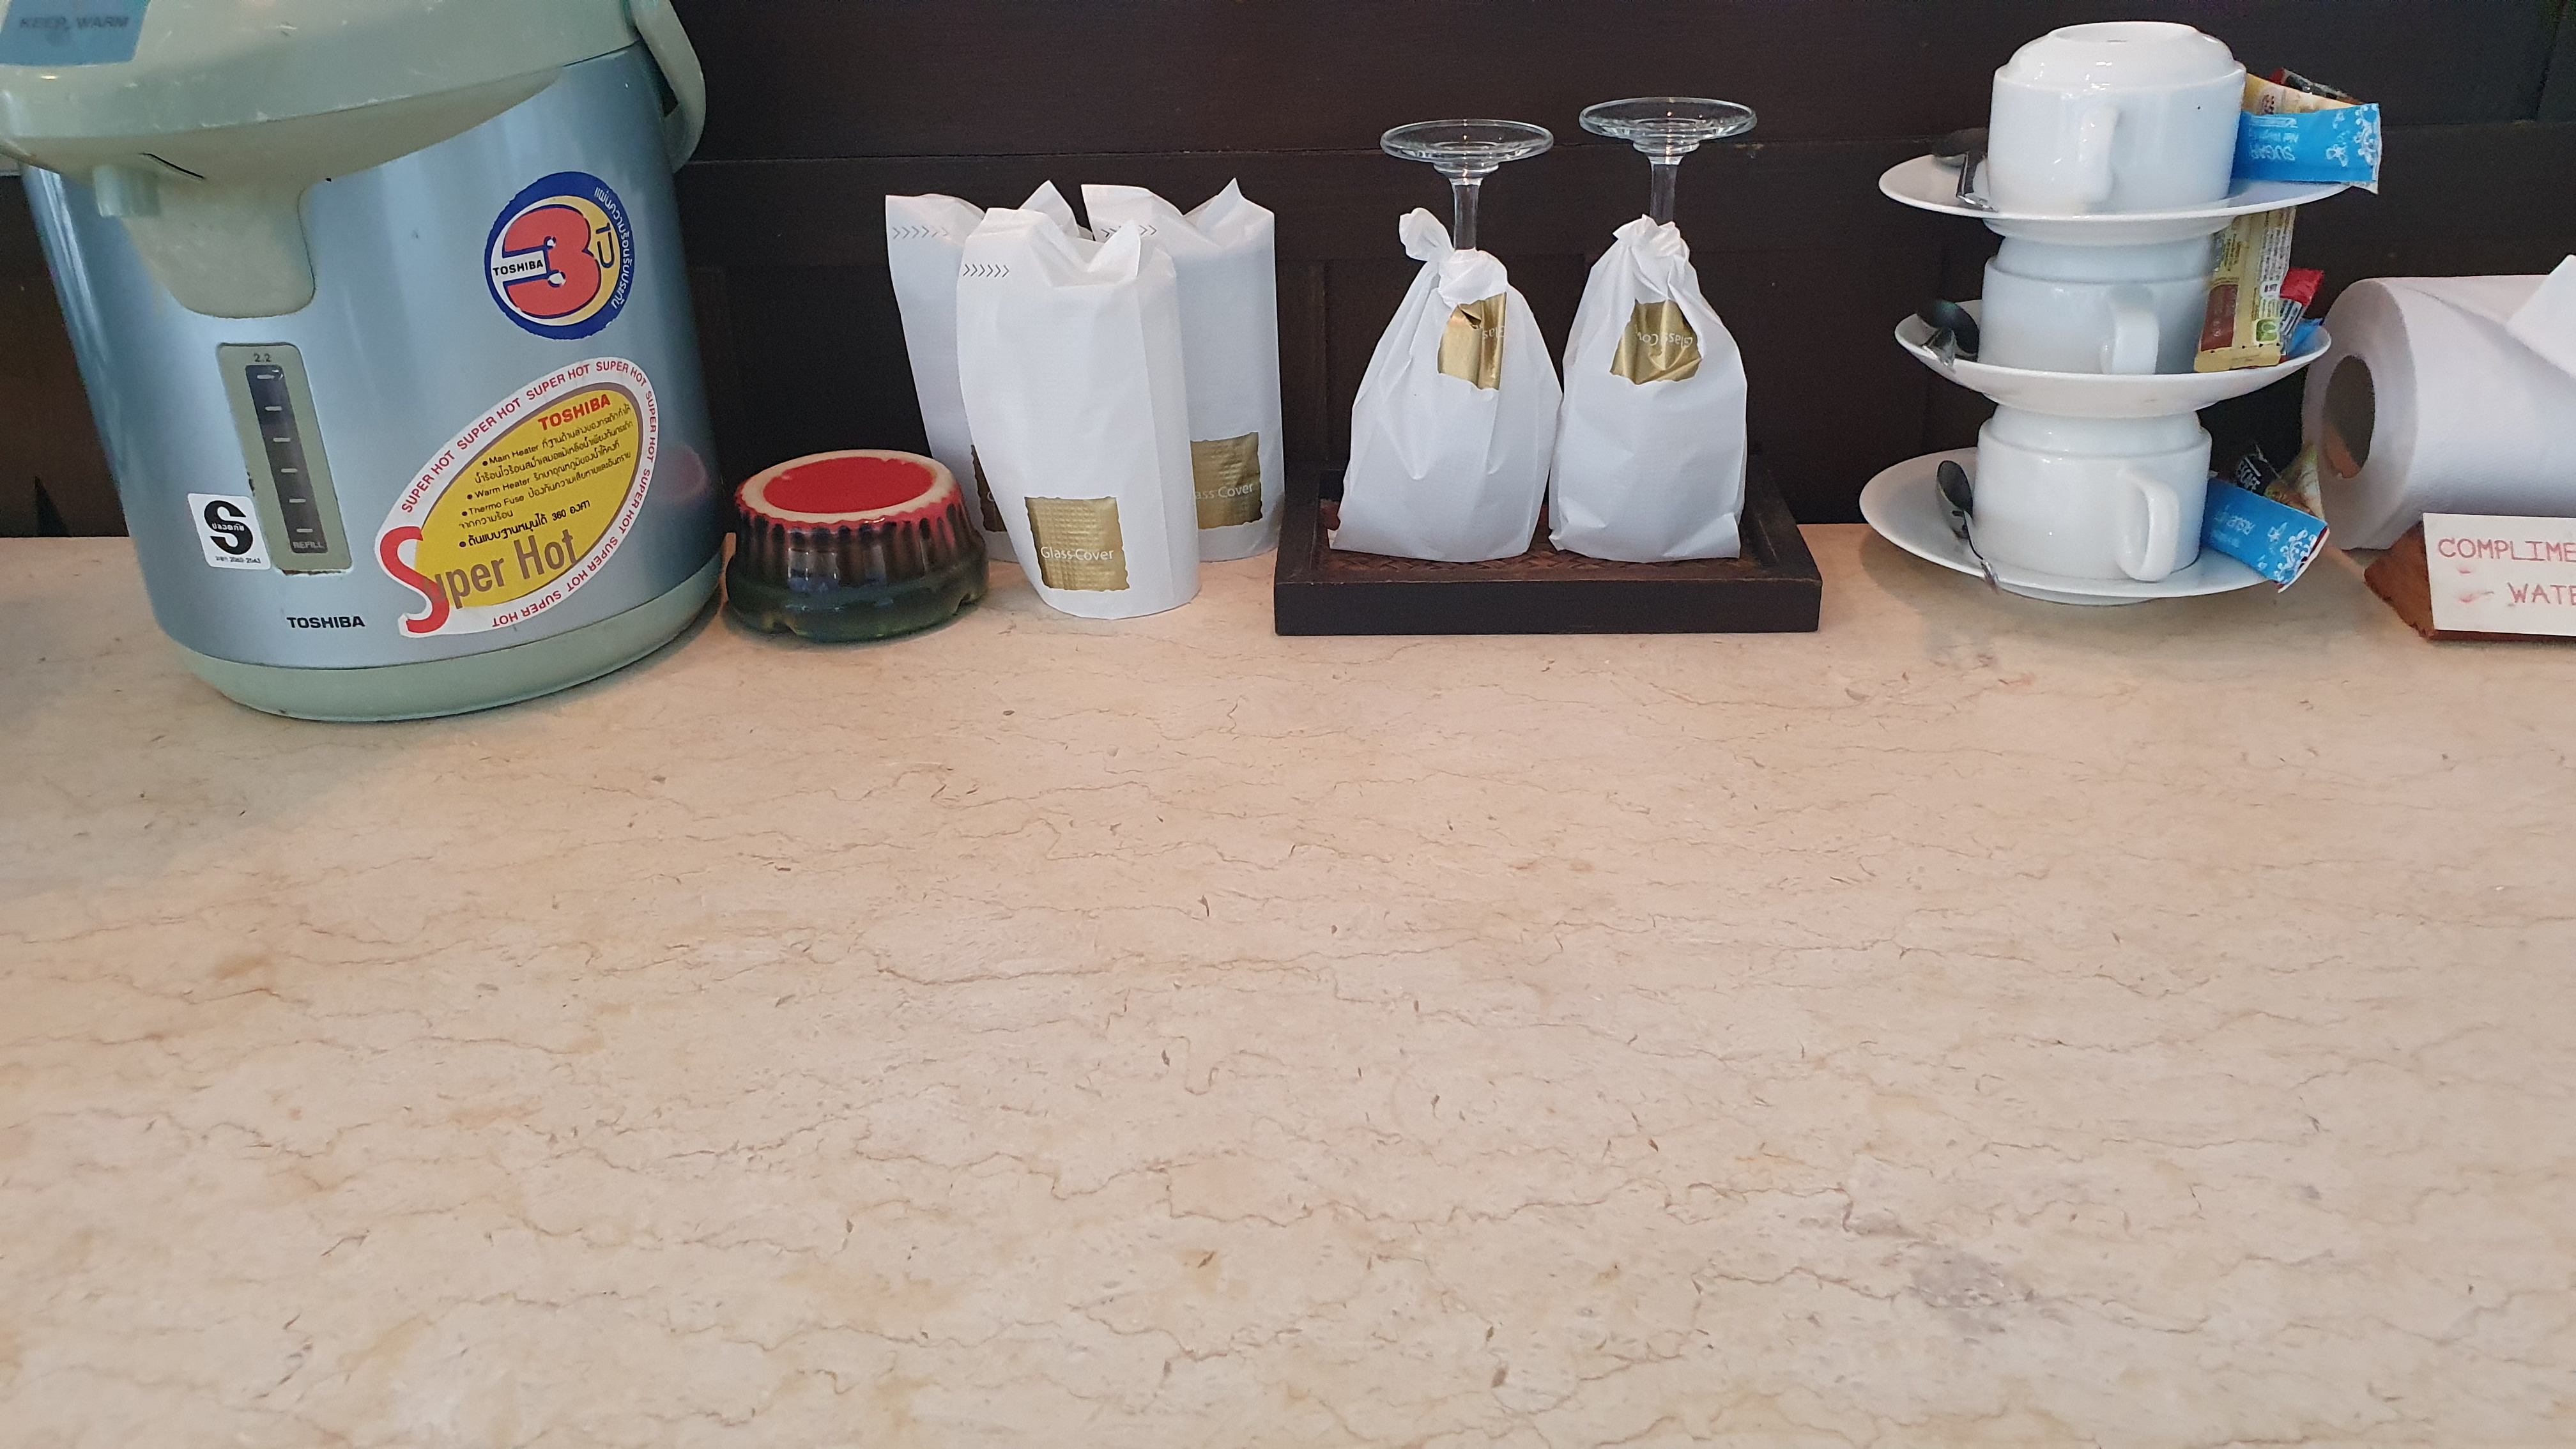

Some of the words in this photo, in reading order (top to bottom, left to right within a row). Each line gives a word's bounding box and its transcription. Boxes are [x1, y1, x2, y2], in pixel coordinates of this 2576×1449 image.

[493, 259, 544, 276] TOSHIBA
[254, 353, 272, 362] 2.2
[596, 361, 629, 373] SUPER
[567, 364, 590, 379] HOT
[630, 367, 647, 387] HOT
[526, 374, 566, 401] SUPER
[496, 397, 521, 419] HOT
[537, 394, 611, 431] TOSHIBA
[645, 390, 657, 433] SUPER
[456, 417, 497, 450] SUPER
[489, 453, 510, 464] Main
[512, 445, 539, 457] Heater
[647, 437, 656, 463] HOT
[431, 450, 456, 475] HOT
[401, 473, 435, 513] SUPER
[475, 486, 500, 498] Warm
[502, 478, 530, 491] Heater
[631, 468, 650, 509] SUPER
[1218, 484, 1254, 498] Cover
[469, 502, 502, 516] Thermo
[503, 494, 525, 506] Fuse
[551, 509, 567, 521] 360
[569, 500, 591, 515] องศา
[618, 509, 635, 534] HOT
[586, 537, 618, 572] SUPER
[1040, 546, 1073, 560] Glass
[1075, 548, 1114, 560] Cover
[380, 526, 505, 633] Super
[514, 529, 578, 579] Hot
[567, 569, 588, 592] HOT
[521, 590, 562, 618] SUPER
[286, 615, 366, 629] TOSHIBA
[492, 611, 519, 627] HOT
